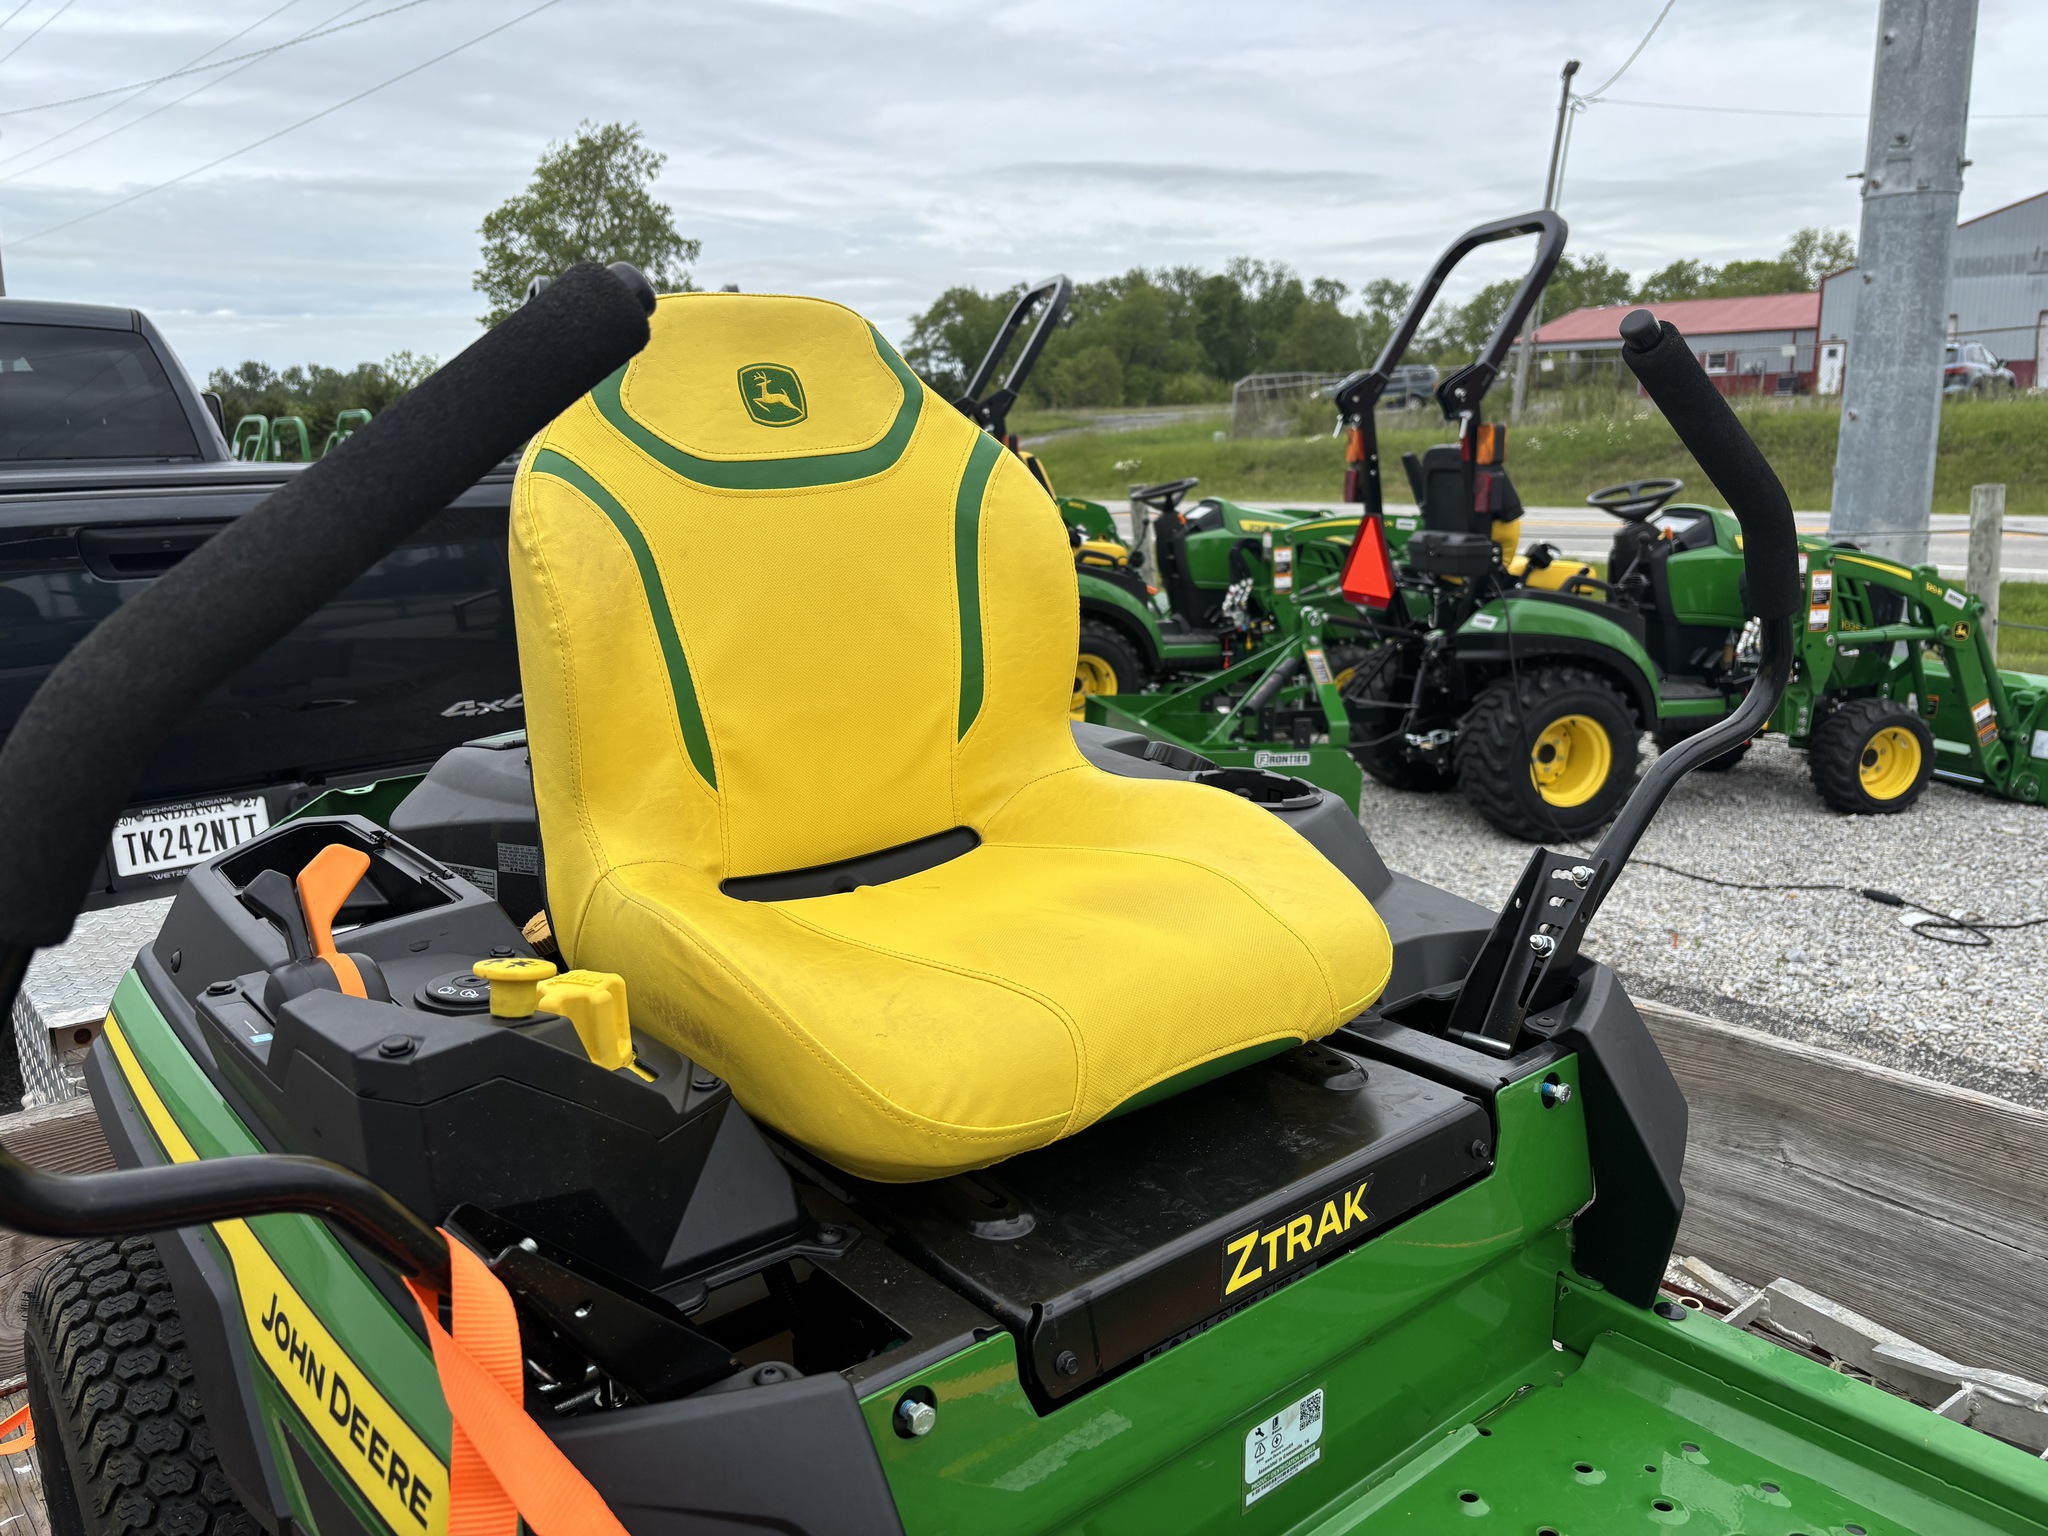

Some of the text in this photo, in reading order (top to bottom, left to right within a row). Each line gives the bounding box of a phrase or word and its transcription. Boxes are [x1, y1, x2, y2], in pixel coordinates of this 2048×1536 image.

[1256, 752, 1309, 766] FRONTIER
[141, 796, 233, 816] RICHMOND, INDIANA
[151, 804, 225, 823] INDIANA
[122, 814, 257, 866] TK242NTT
[153, 868, 190, 881] WETZE
[1225, 1182, 1369, 1296] ZTRAK
[261, 1292, 433, 1531] JOHN DEERE
